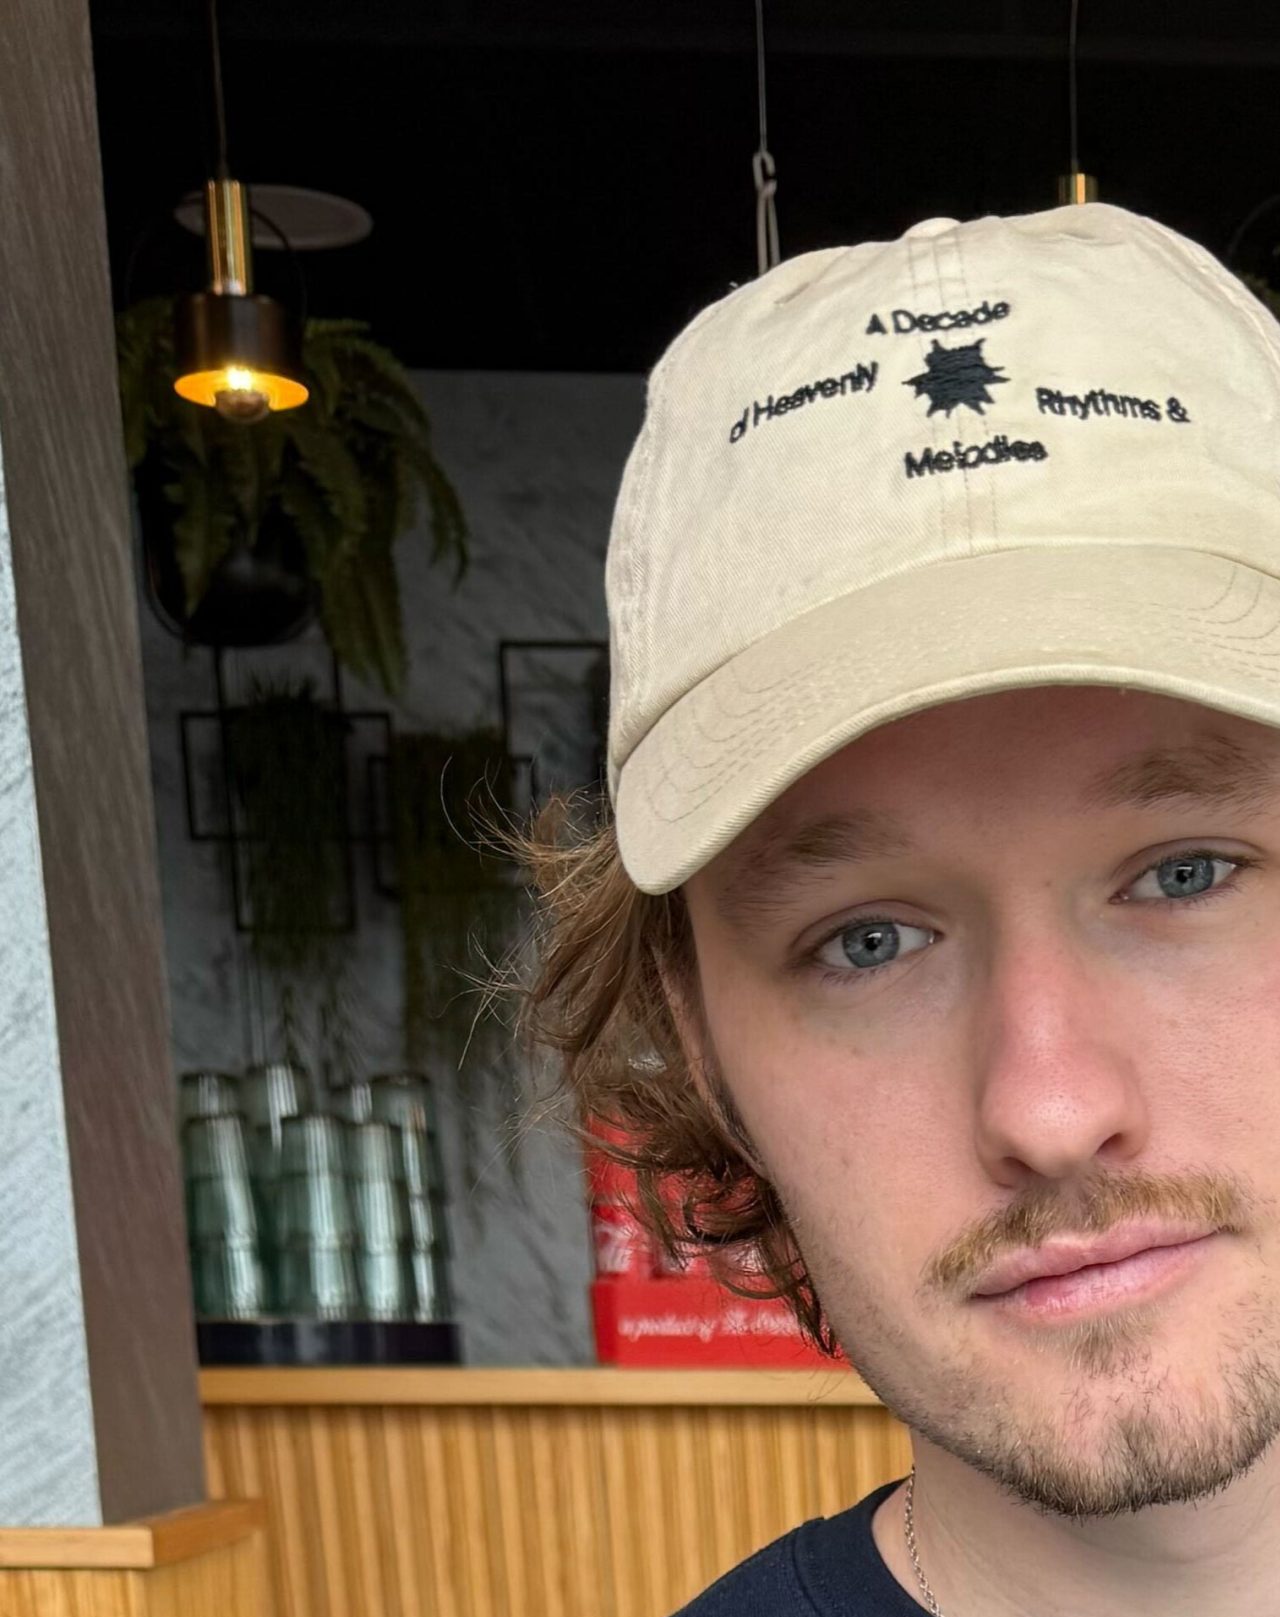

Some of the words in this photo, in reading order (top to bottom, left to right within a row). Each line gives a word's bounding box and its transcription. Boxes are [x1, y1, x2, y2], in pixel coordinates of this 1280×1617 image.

[866, 313, 888, 335] A
[892, 300, 1010, 334] Decade
[753, 361, 879, 428] Heavenly
[1035, 387, 1162, 421] Rhythms
[1166, 397, 1191, 423] &
[904, 435, 1048, 479] Melodies
